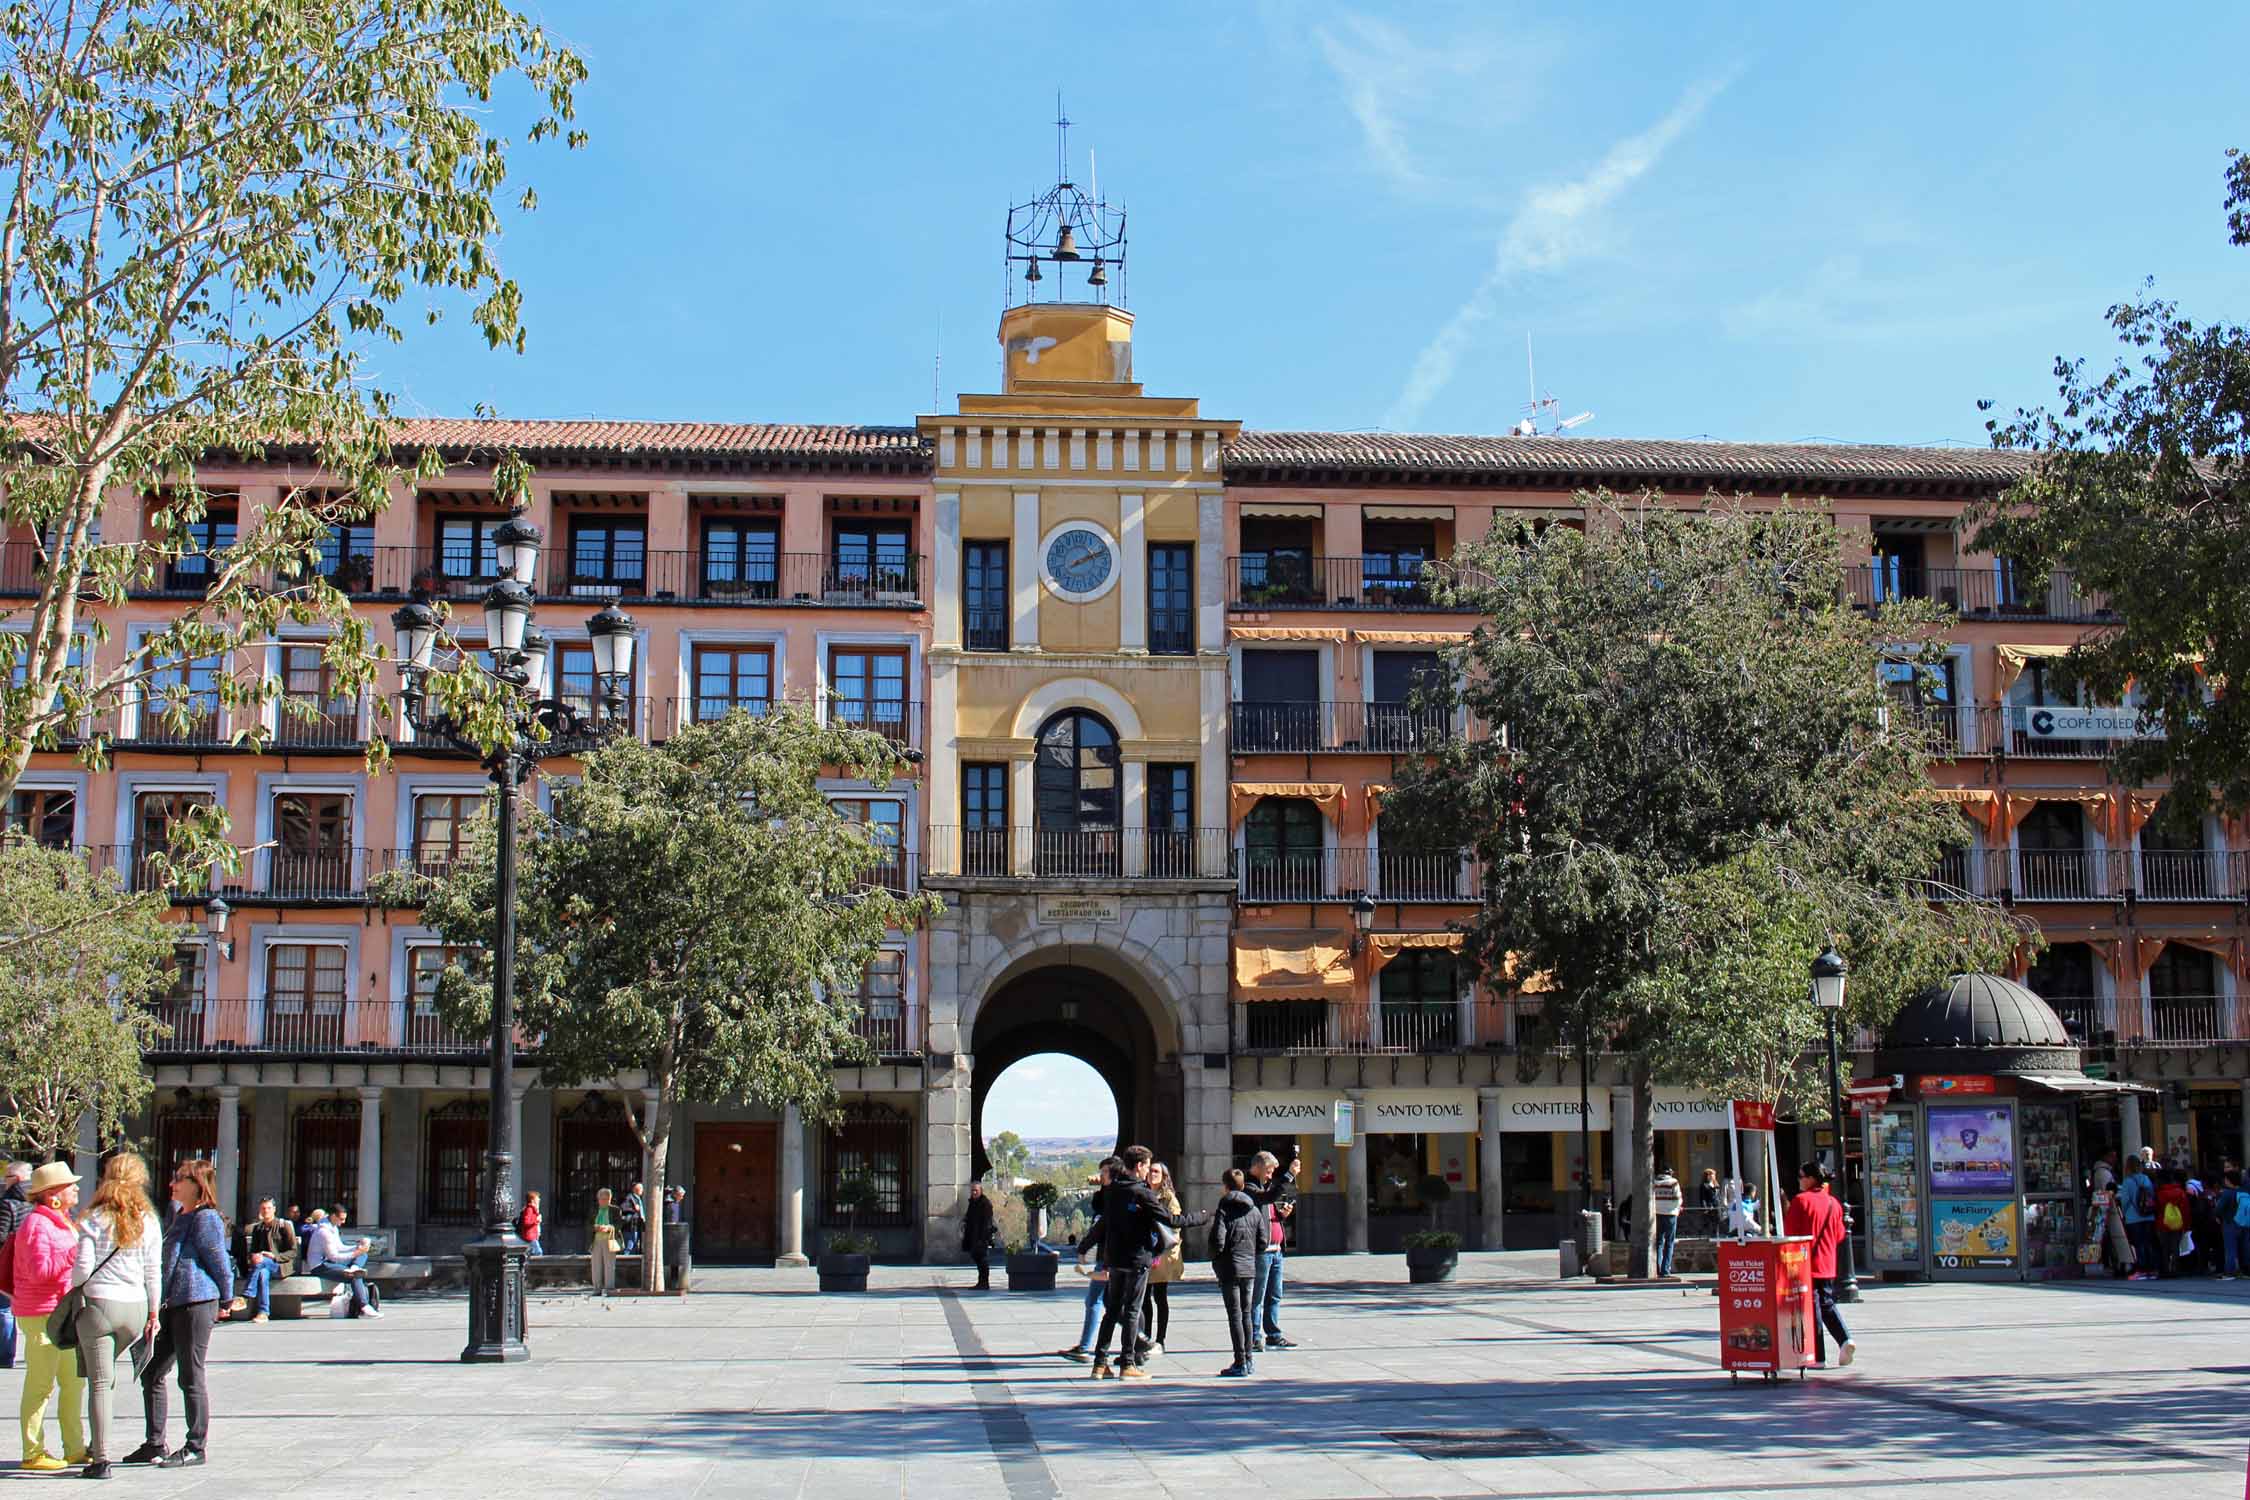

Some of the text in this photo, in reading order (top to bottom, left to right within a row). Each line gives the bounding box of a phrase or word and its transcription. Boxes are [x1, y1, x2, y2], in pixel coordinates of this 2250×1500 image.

[2057, 717, 2092, 729] COPE
[2095, 717, 2138, 730] TOLED
[1254, 1104, 1326, 1118] MAZAPAN
[1376, 1104, 1423, 1117] SANTO
[1951, 1205, 1993, 1217] McFlurry
[1938, 1255, 1959, 1268] YO
[1740, 1270, 1755, 1283] 24
